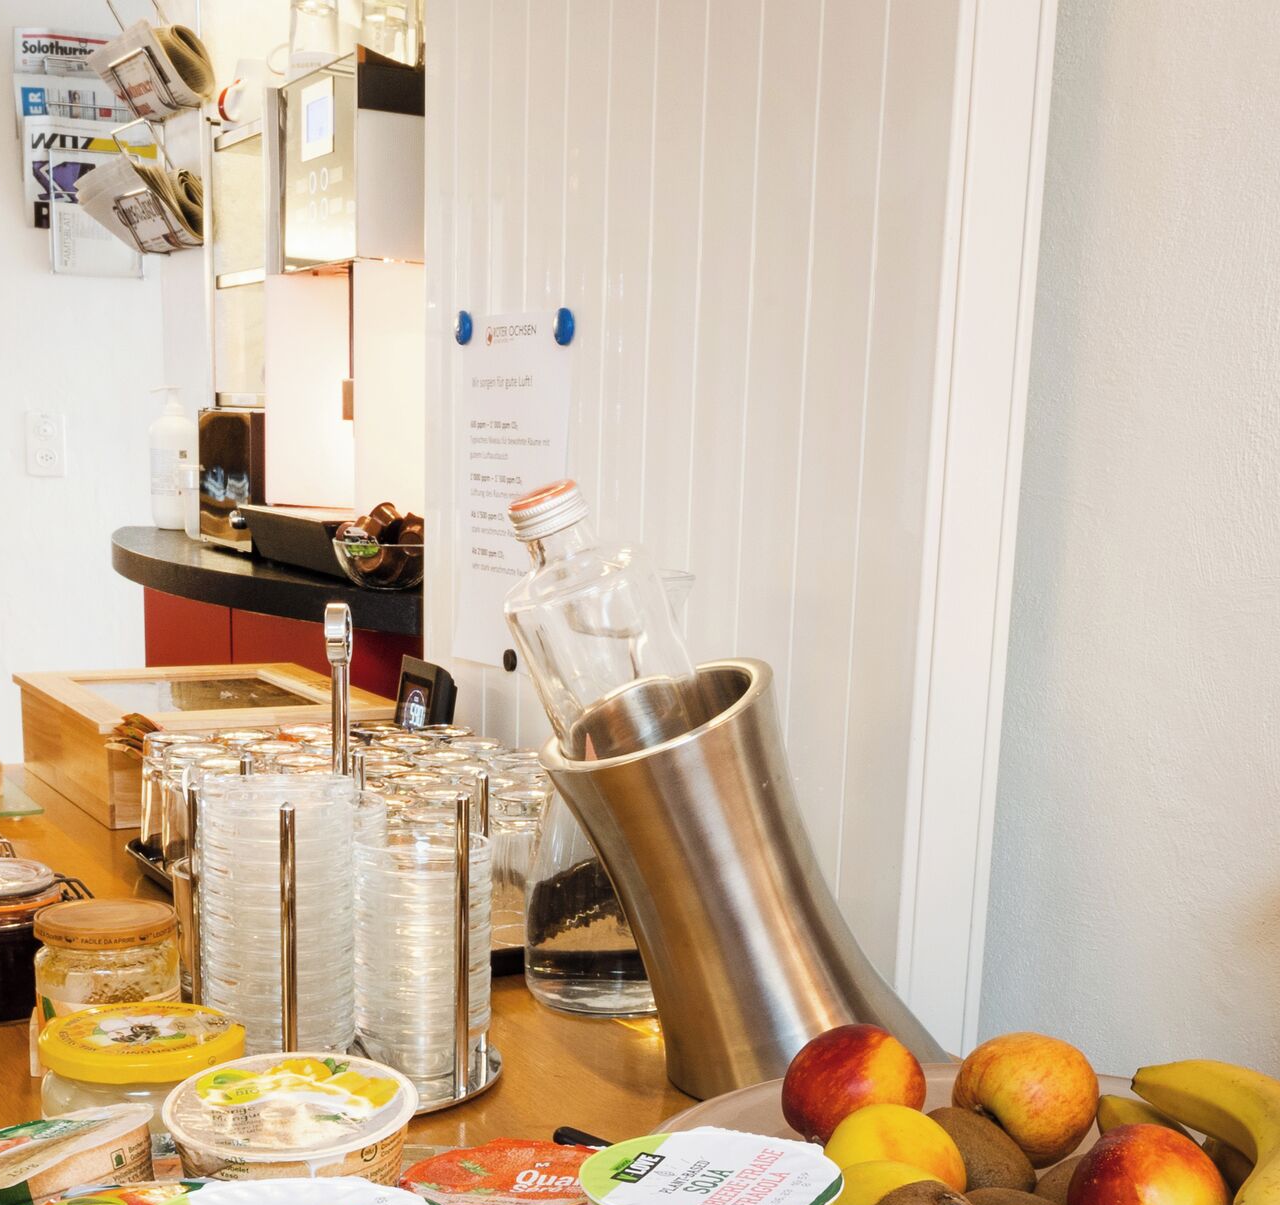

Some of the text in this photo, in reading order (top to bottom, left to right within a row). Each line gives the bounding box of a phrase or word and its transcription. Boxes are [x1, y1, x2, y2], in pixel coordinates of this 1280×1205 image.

[509, 324, 536, 336] OCHSEN
[81, 936, 101, 945] FACILE
[683, 1168, 734, 1194] SOJA
